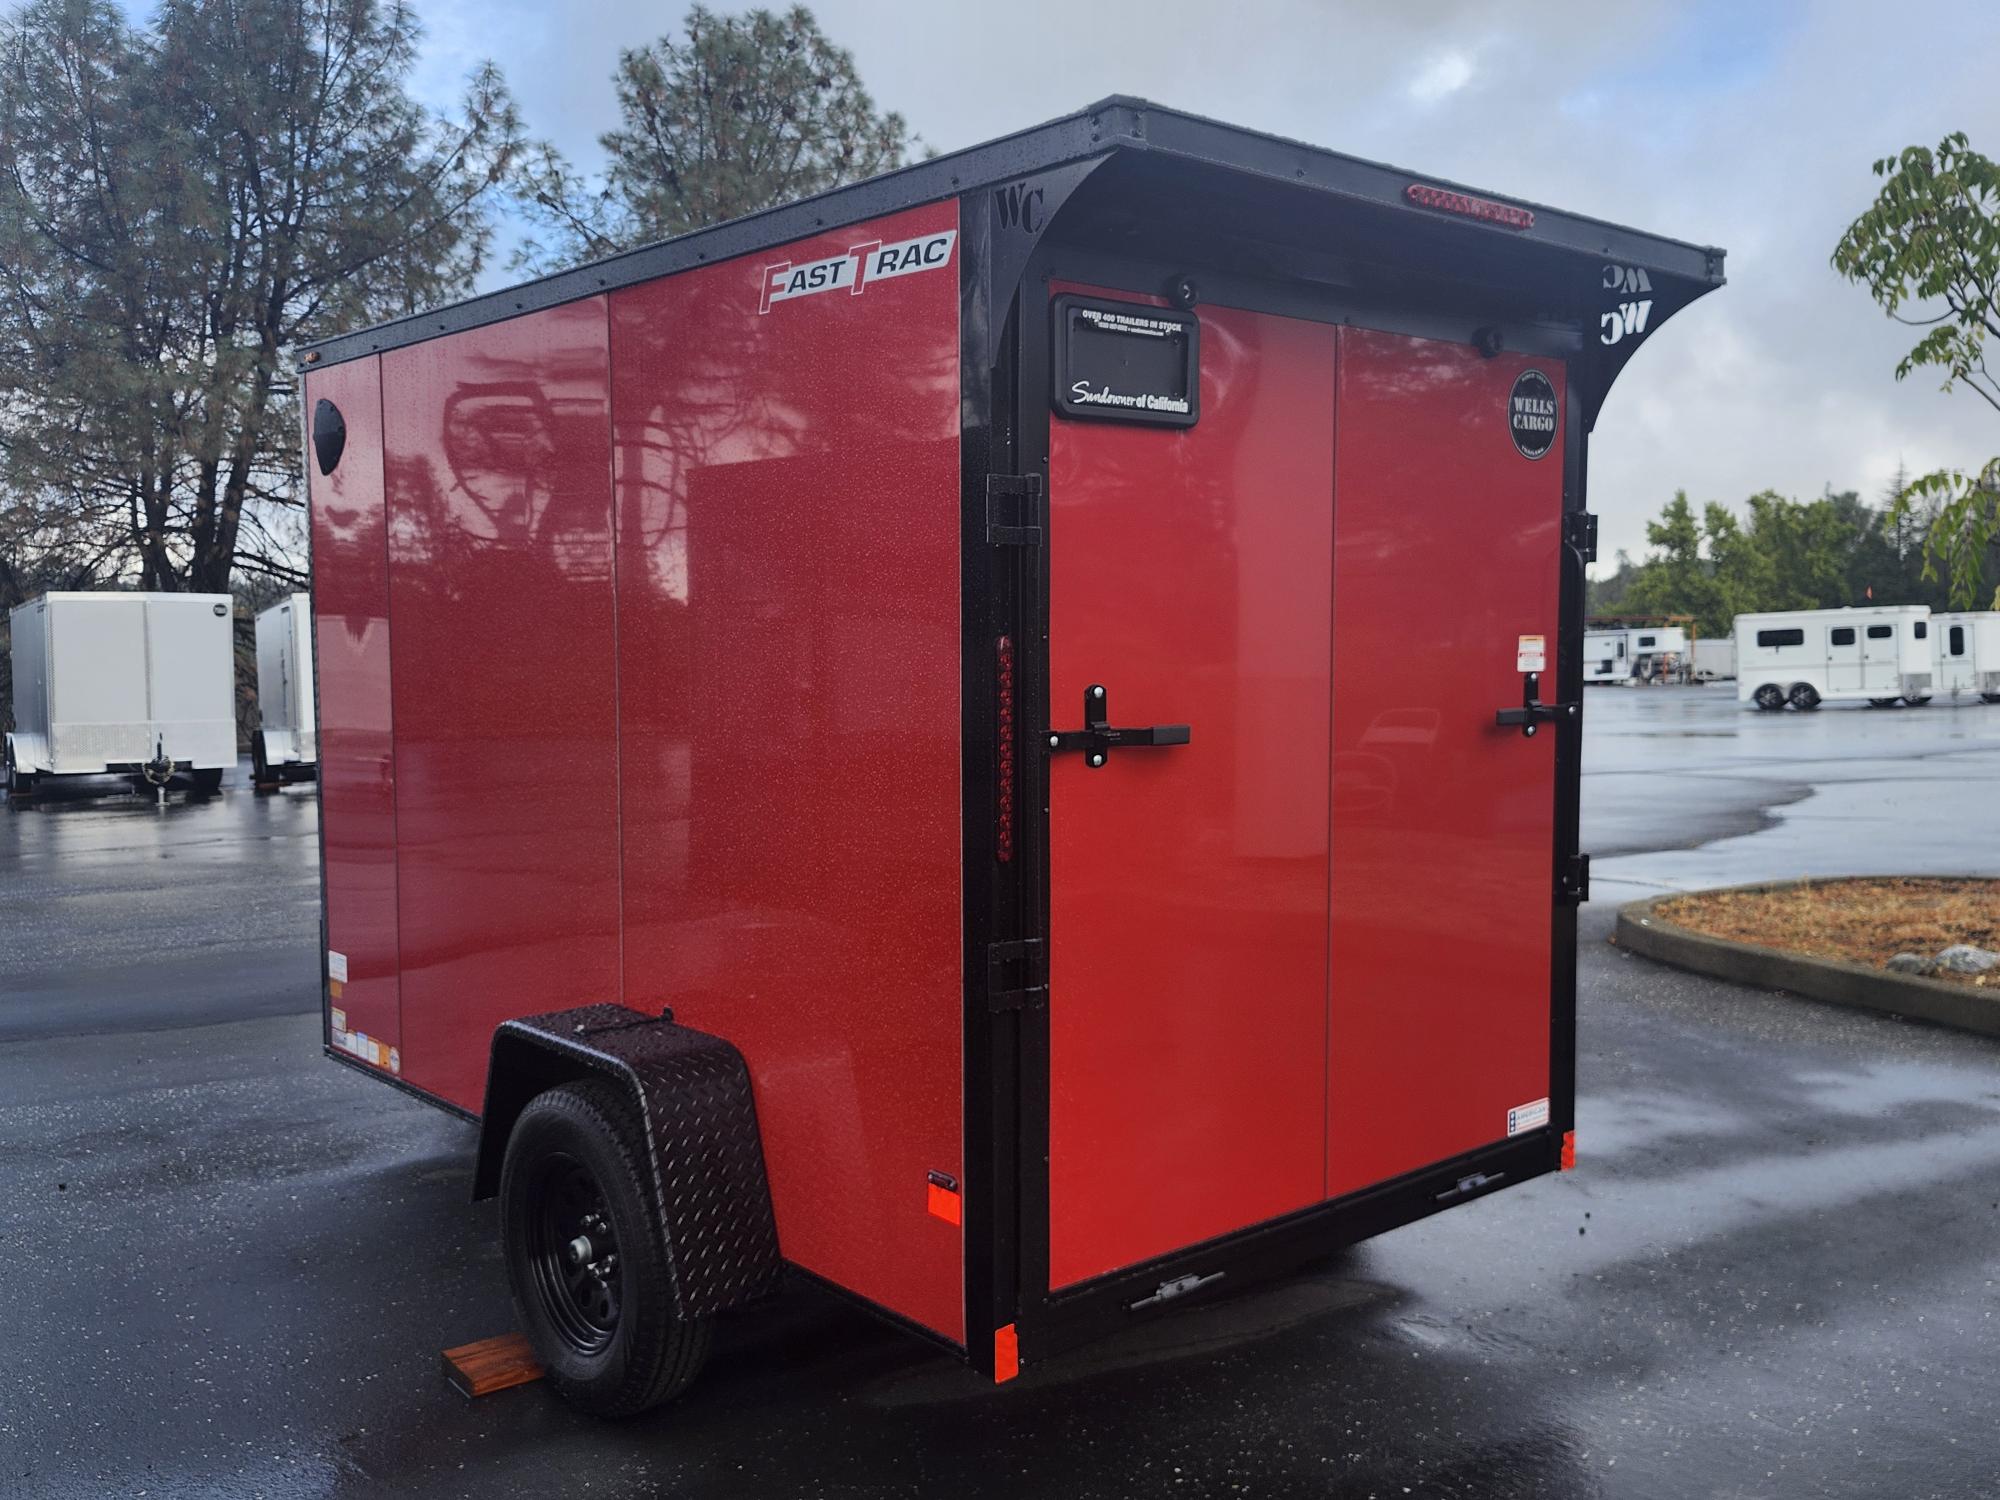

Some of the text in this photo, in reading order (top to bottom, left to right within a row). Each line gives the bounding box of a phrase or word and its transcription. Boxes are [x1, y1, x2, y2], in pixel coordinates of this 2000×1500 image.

[995, 182, 1044, 234] WC
[1082, 310, 1102, 321] OVER
[1102, 313, 1116, 322] 400
[1116, 315, 1149, 328] TRAILERS
[1150, 321, 1158, 329] IN
[1158, 322, 1182, 332] STOCK
[1071, 381, 1189, 414] Sundowner of California
[1513, 397, 1554, 415] WELLS
[1513, 413, 1554, 432] CARGO
